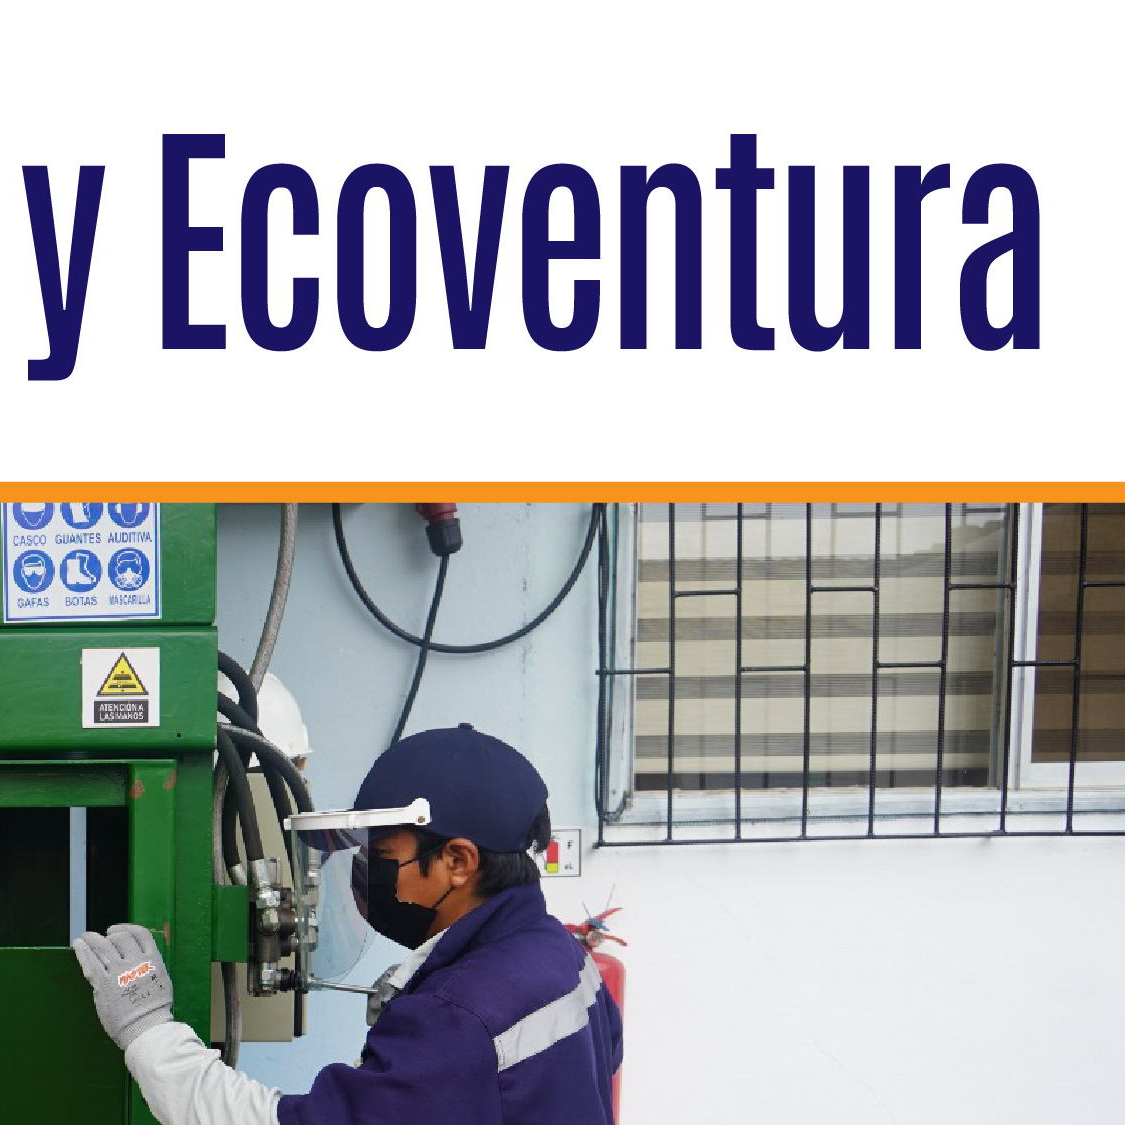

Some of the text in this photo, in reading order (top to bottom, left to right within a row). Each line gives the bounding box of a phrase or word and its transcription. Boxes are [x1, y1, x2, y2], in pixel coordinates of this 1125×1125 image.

[13, 531, 153, 546] CASCO GUANTES AUDITIVA
[17, 594, 151, 609] GAFAS BOTAS MASCARILLA
[137, 703, 144, 712] A
[99, 711, 144, 720] LAS MANOS
